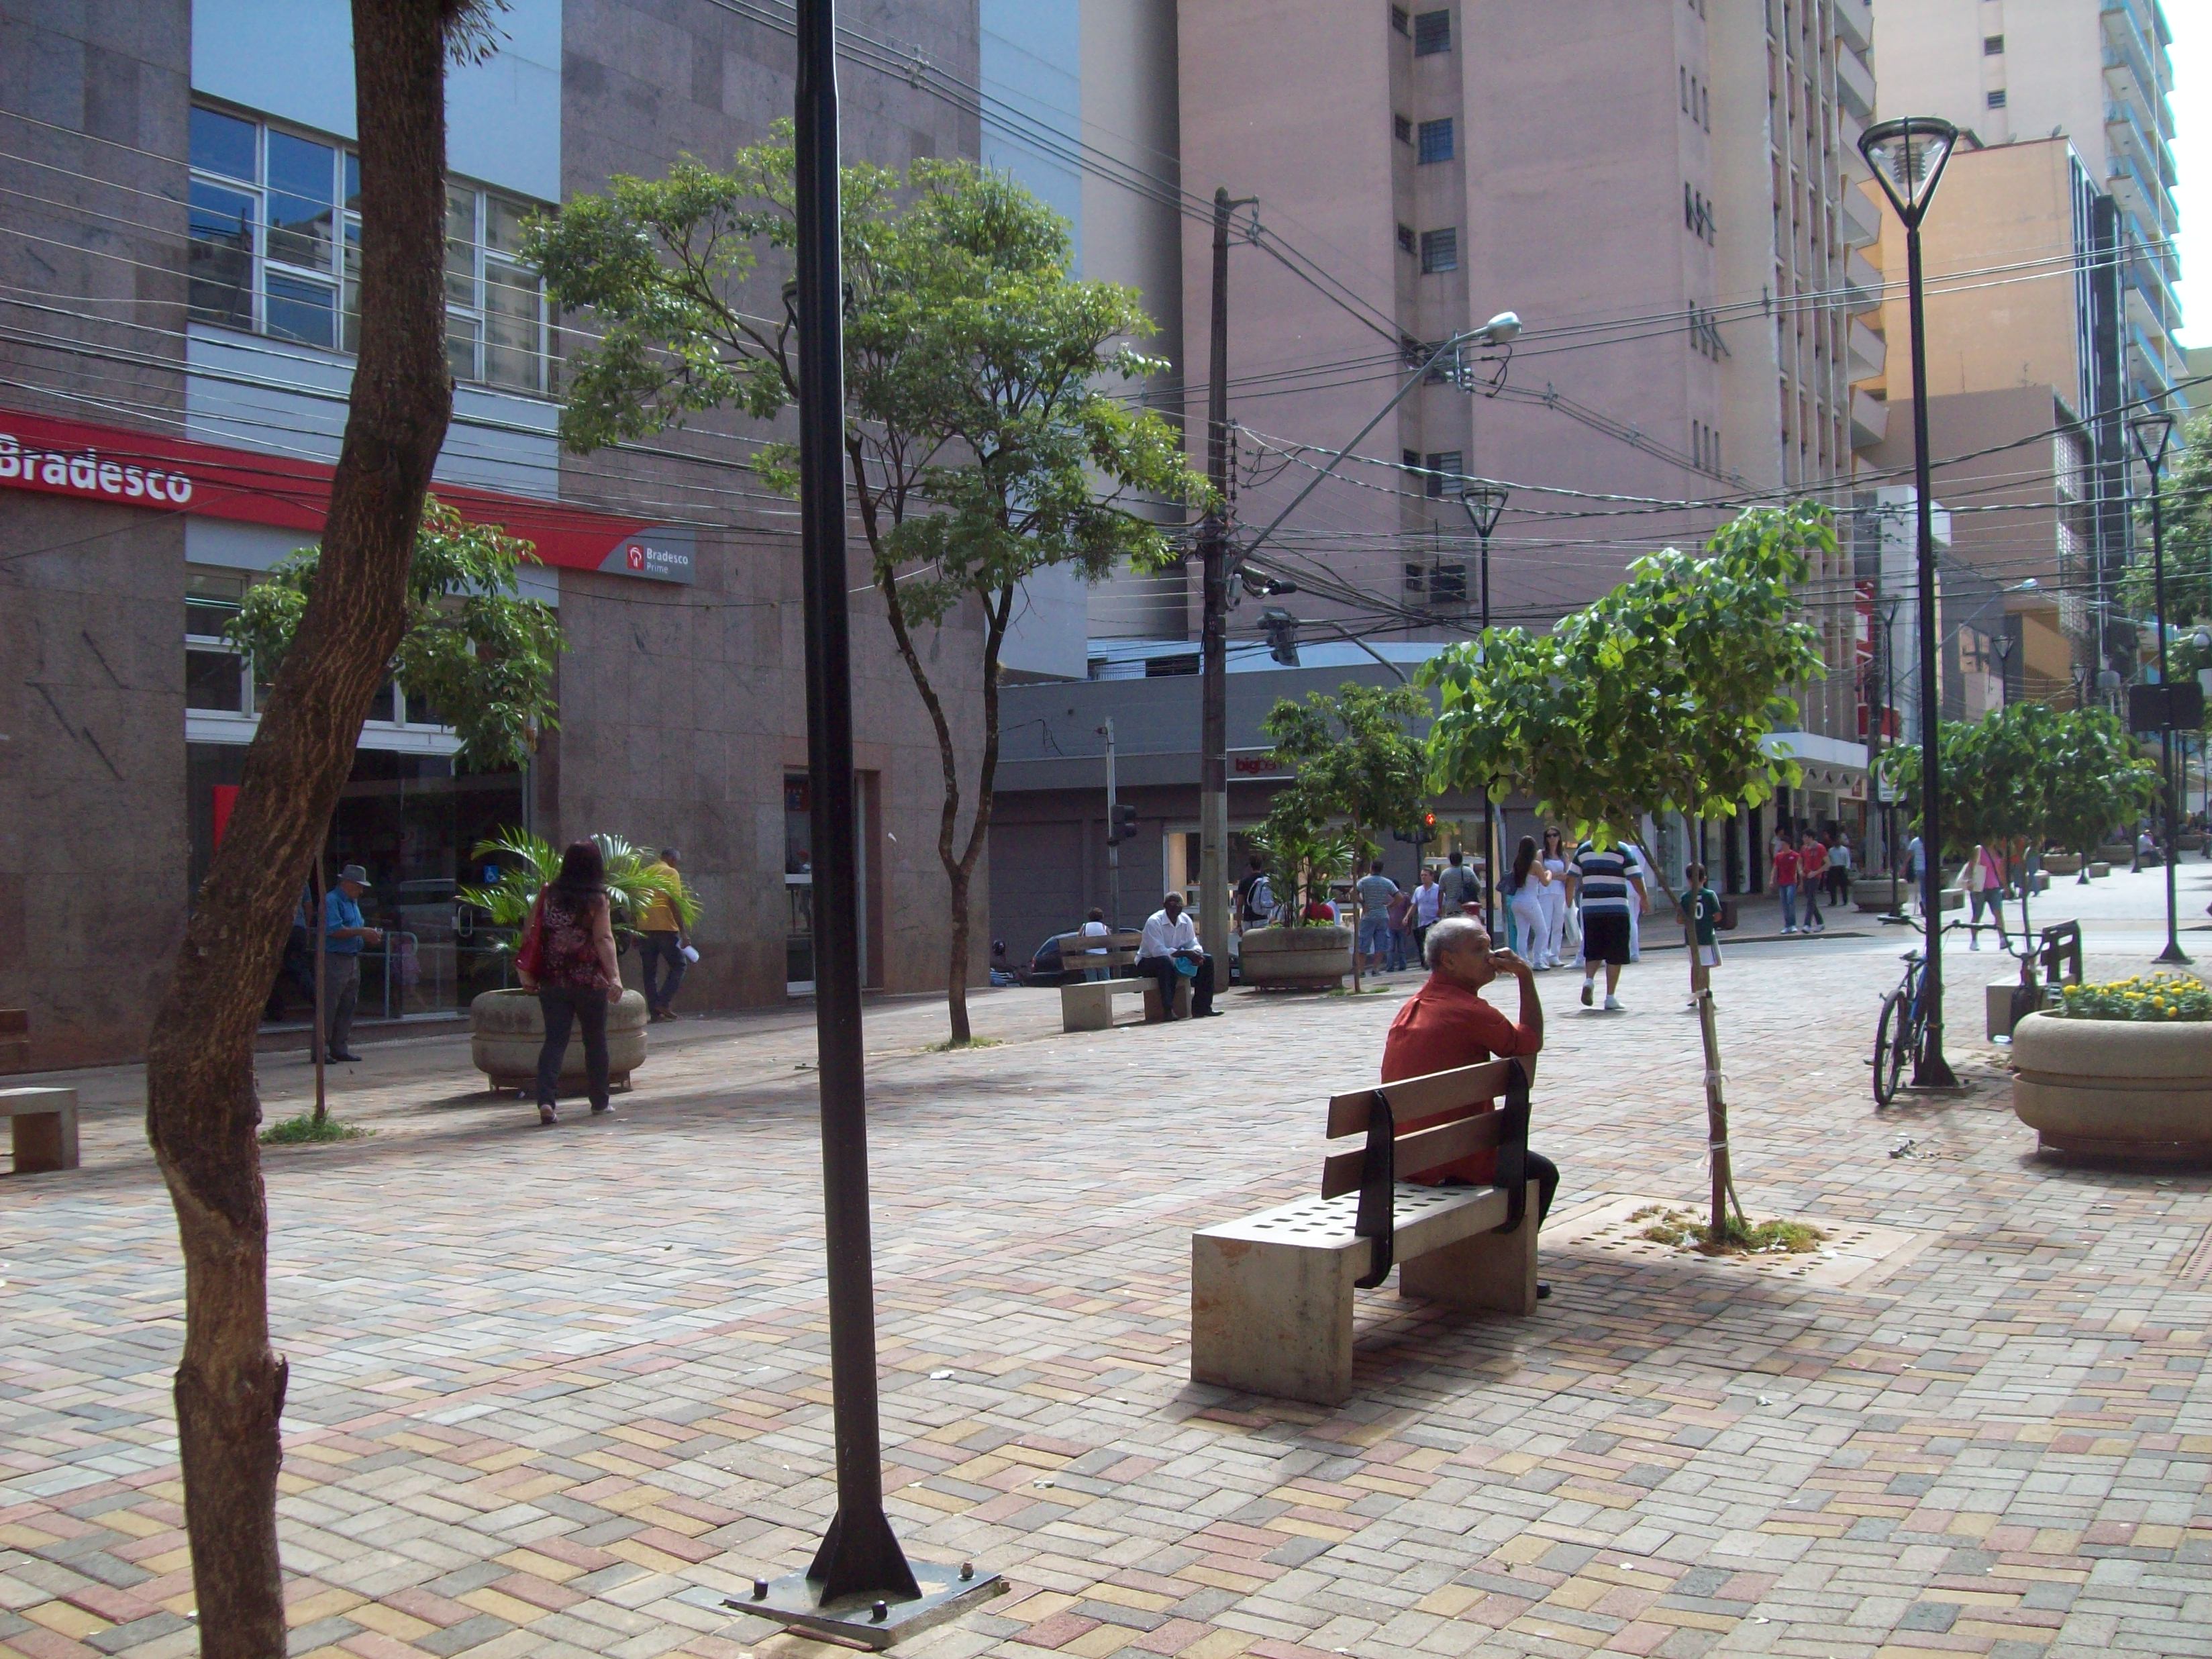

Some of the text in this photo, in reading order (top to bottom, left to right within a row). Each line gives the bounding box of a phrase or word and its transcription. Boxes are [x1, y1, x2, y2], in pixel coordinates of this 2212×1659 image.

[0, 434, 192, 503] Bradesco
[646, 548, 688, 564] Bradesco
[646, 562, 668, 573] Prime
